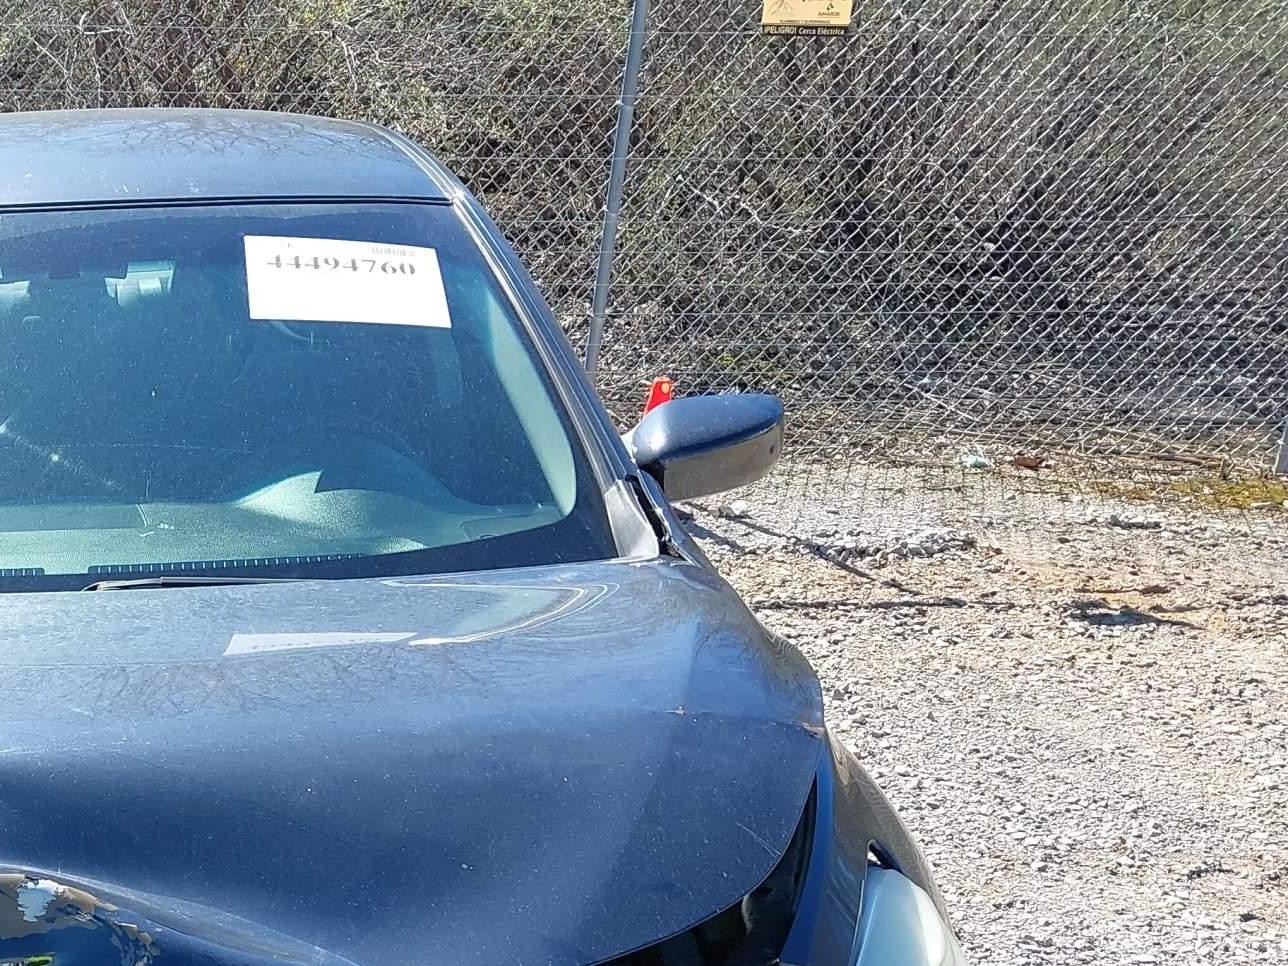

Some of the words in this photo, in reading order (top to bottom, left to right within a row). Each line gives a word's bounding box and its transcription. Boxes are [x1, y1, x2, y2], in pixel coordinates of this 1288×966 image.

[798, 27, 817, 35] Cerca
[817, 27, 845, 35] Eléctrica
[267, 254, 416, 275] 44494760
